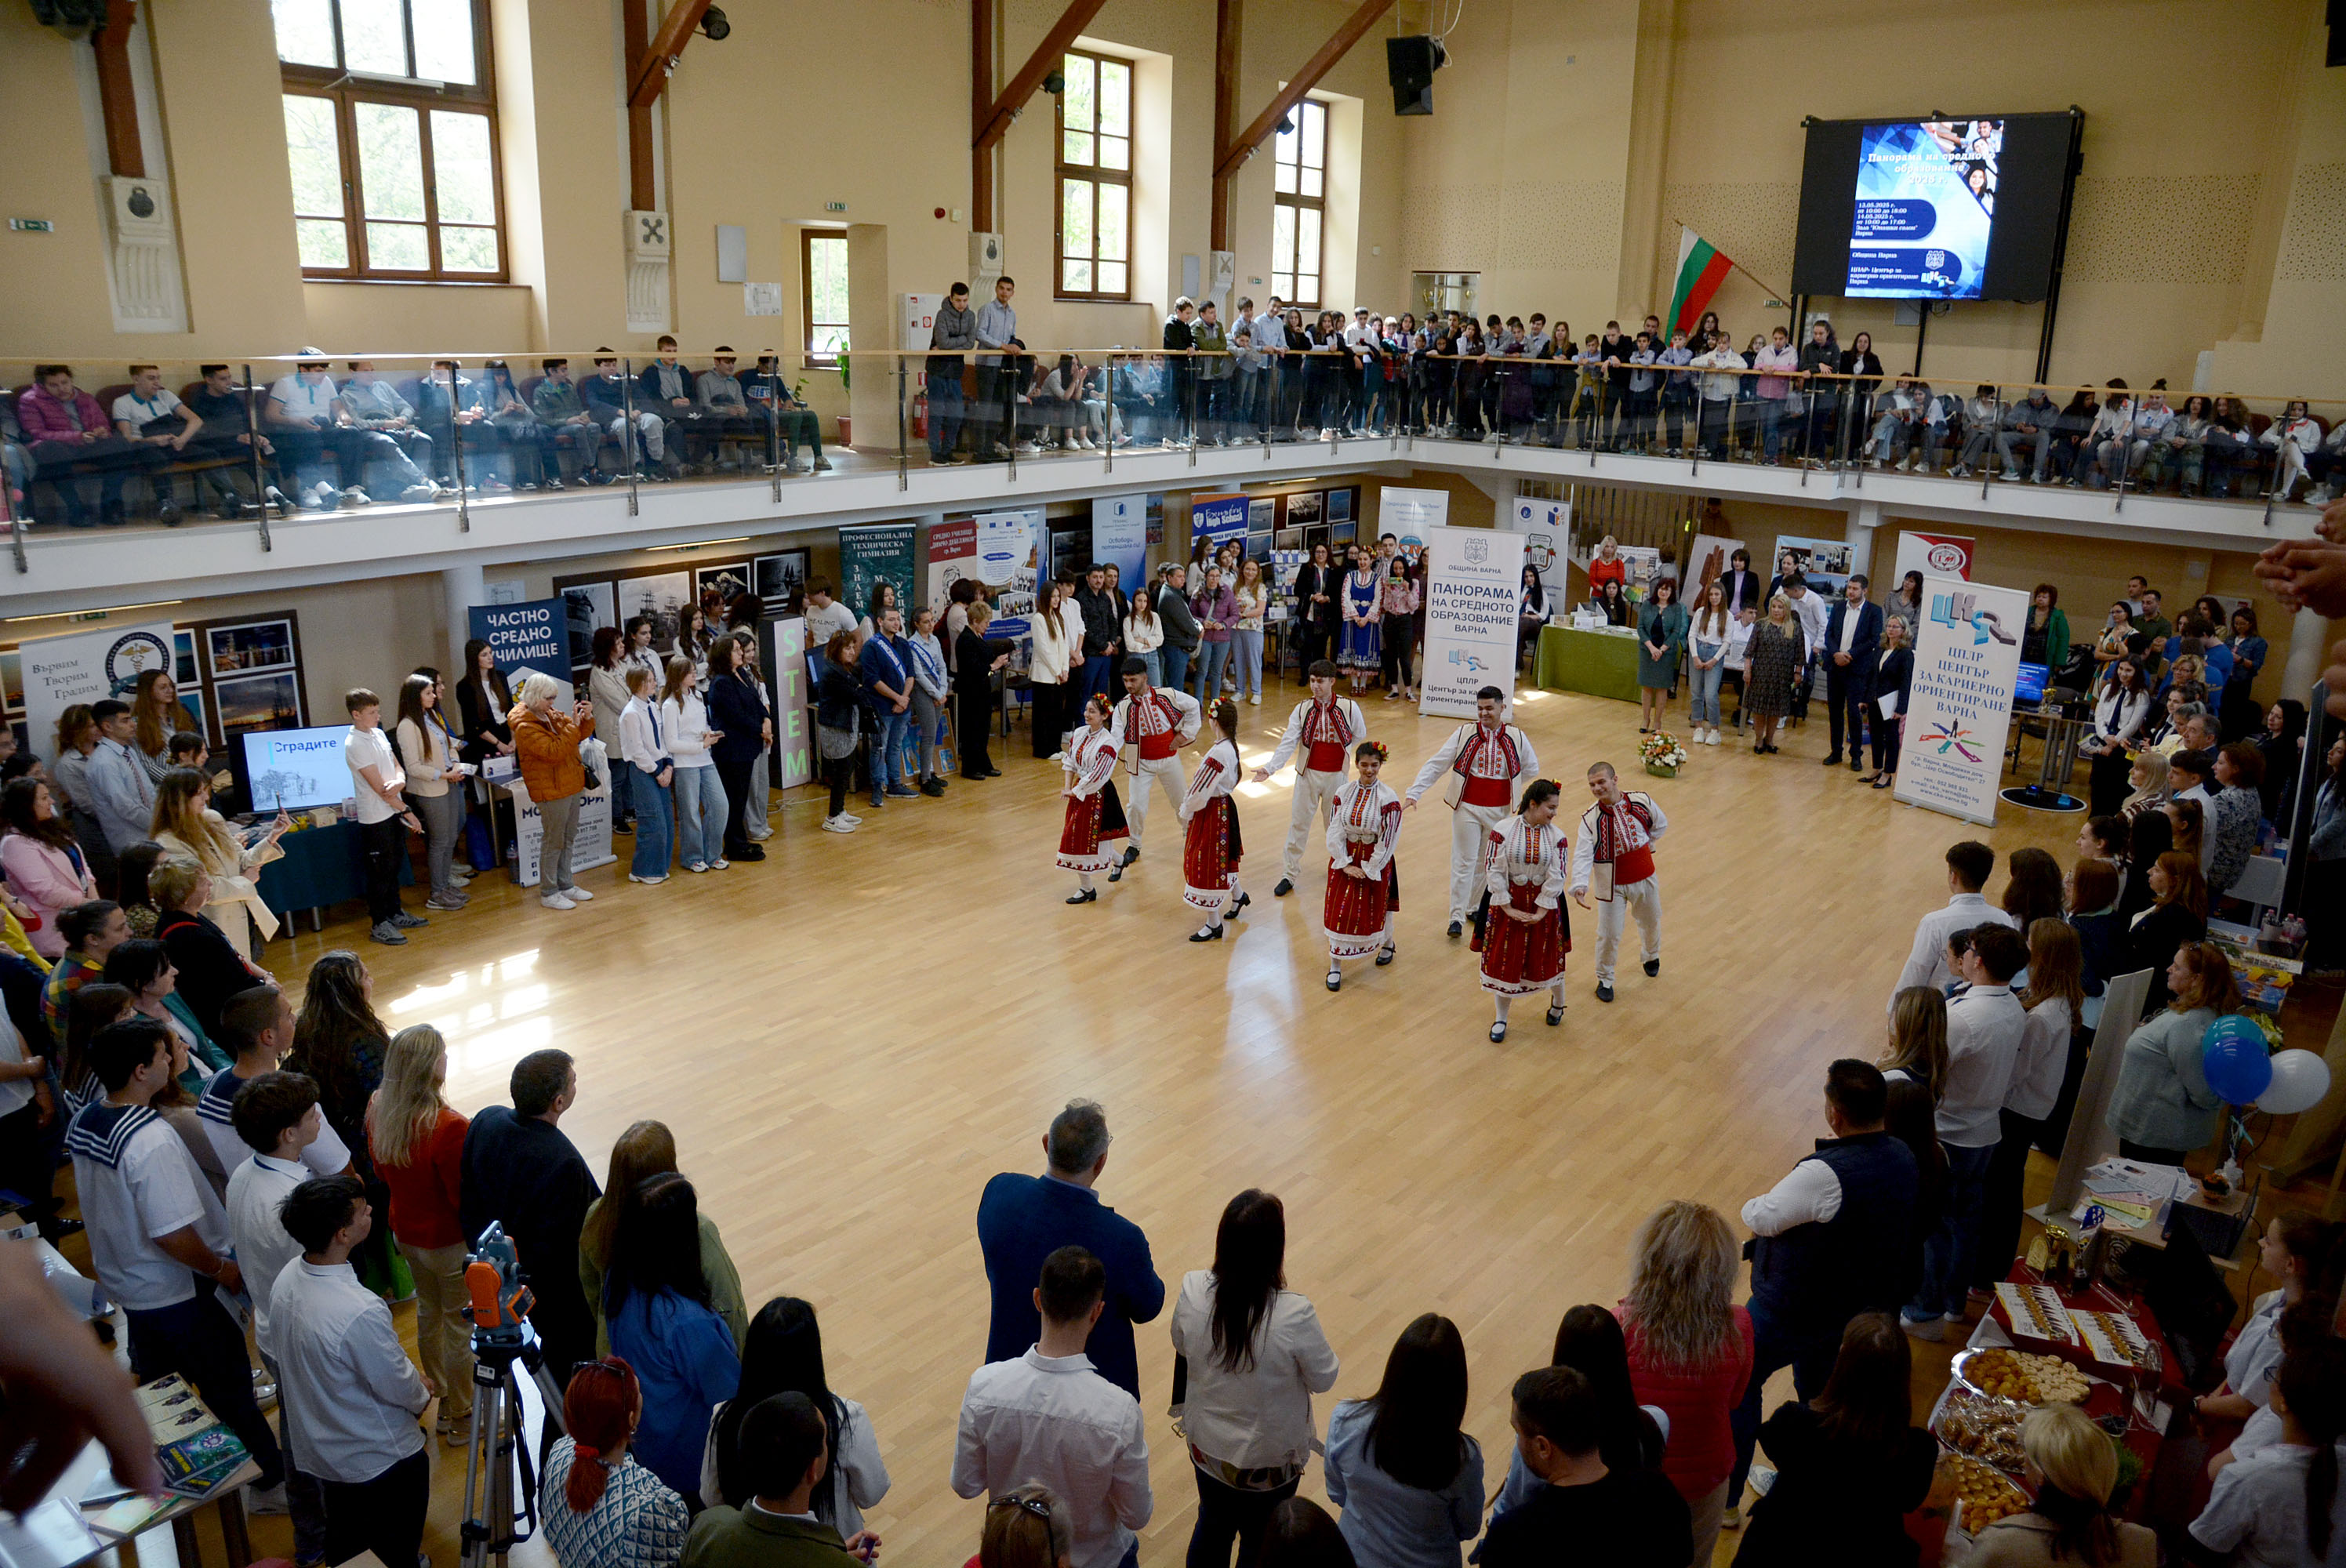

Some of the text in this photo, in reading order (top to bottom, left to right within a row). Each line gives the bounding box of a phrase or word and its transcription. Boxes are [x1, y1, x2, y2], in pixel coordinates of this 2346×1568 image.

[1868, 153, 1922, 163] Панорама
[1942, 152, 1996, 161] средното
[1894, 165, 1965, 173] образование
[842, 532, 913, 542] ПРОФЕСИОНАЛНА
[932, 532, 950, 540] СРЕДНО
[951, 528, 973, 538] УЧИЛИЩЕ
[852, 541, 904, 550] ТЕХНИЧЕСКА
[857, 550, 900, 558] ГИМНАЗИЯ
[853, 564, 864, 608] ЗНАЕМ
[1433, 583, 1514, 600] ПАНОРАМА
[1432, 597, 1514, 613] НА СРЕДНОТО
[487, 608, 550, 626] ЧАСТНО
[1431, 610, 1513, 626] ОБРАЗОВАНИЕ
[488, 626, 552, 645] СРЕДНО
[1454, 624, 1487, 634] ВАРНА
[1948, 647, 1984, 662] ЦПЛР
[32, 660, 78, 674] Вървим
[1938, 660, 1989, 679] ЦЕНТЪР
[43, 673, 89, 687] Творим
[1919, 670, 1933, 681] ЗА
[1937, 673, 2005, 697] КАРИЕРНО
[54, 684, 100, 700] Градим
[1428, 684, 1457, 695] Център
[783, 629, 808, 779] STEM
[1426, 695, 1477, 706] ориентиране
[1913, 684, 2006, 713] ОРИЕНТИРАНЕ
[1937, 702, 1977, 720] ВАРНА
[274, 739, 336, 753] Сградите
